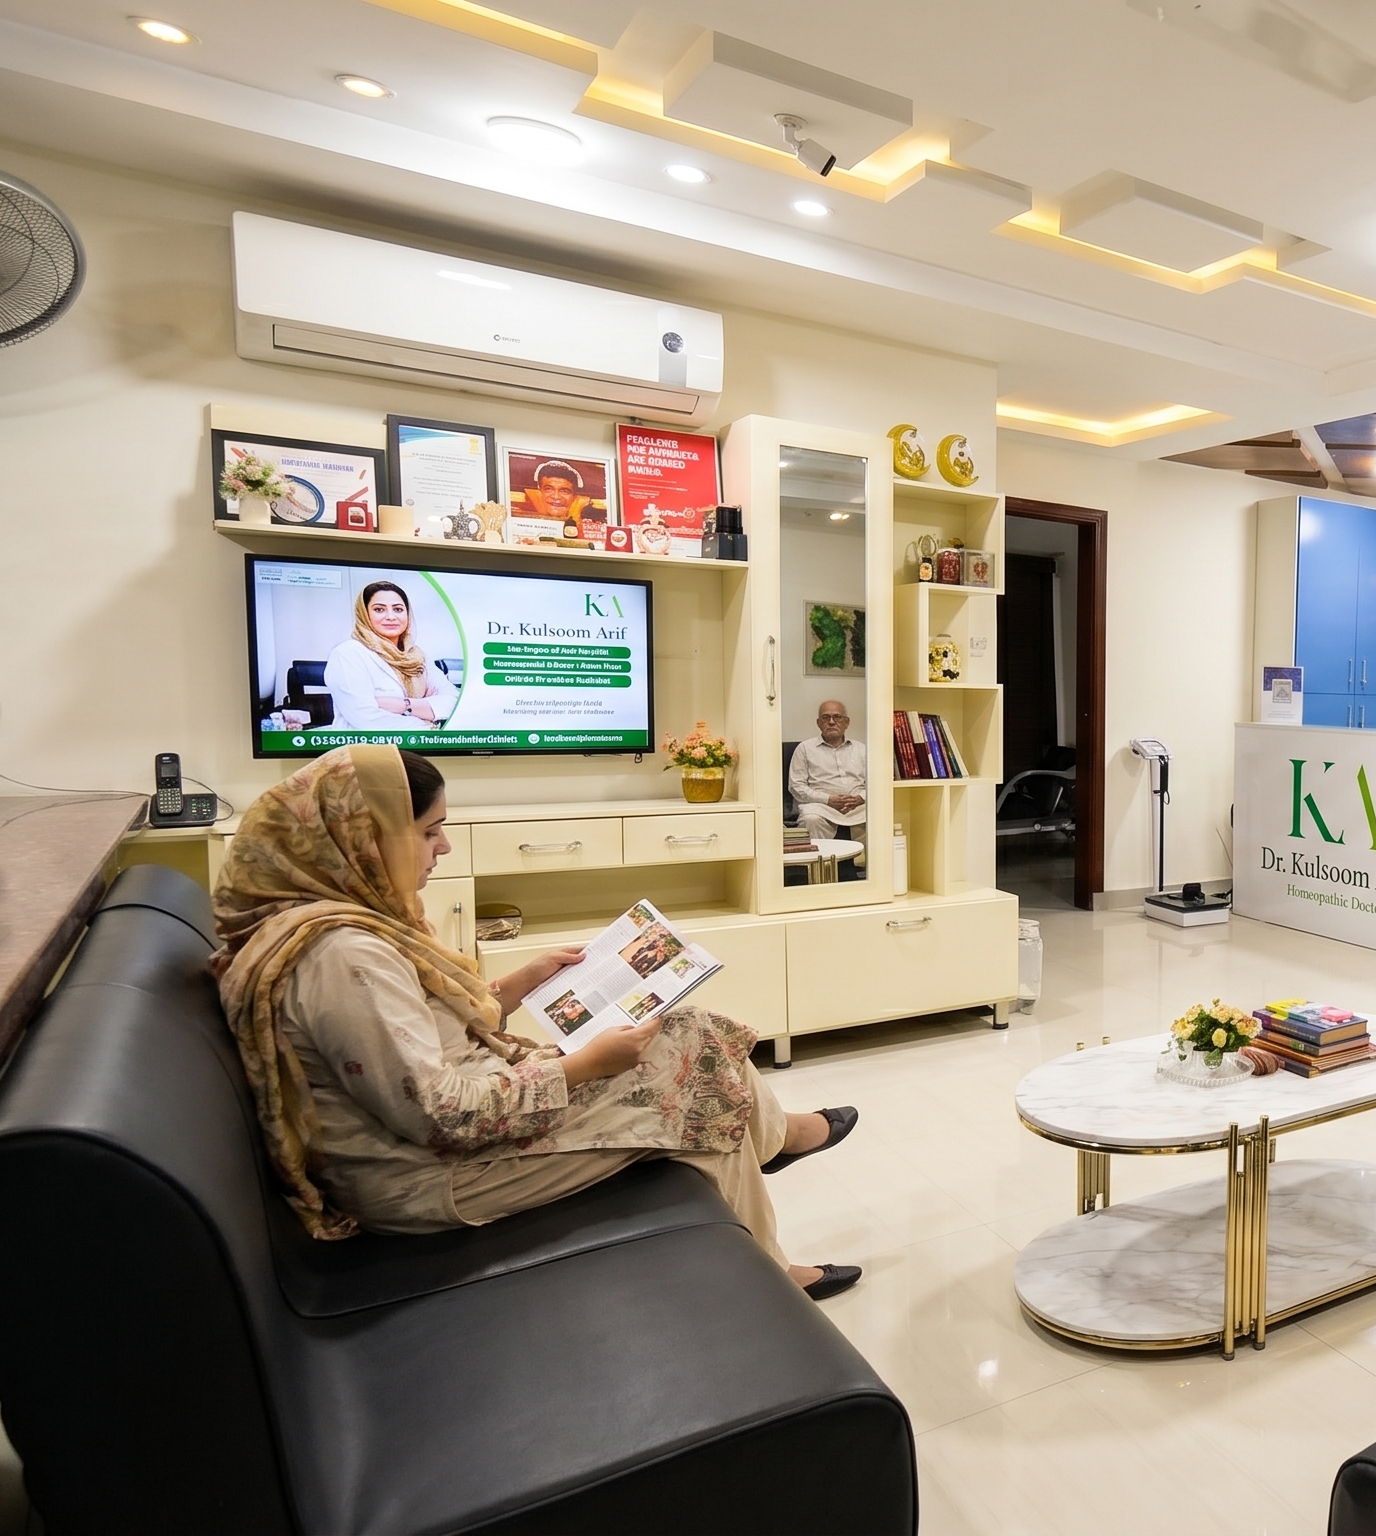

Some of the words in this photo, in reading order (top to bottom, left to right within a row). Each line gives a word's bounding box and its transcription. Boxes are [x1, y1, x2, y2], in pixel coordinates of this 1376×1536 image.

[627, 454, 647, 465] ARE
[487, 620, 514, 635] Dr.
[518, 622, 592, 639] Kulsoom
[596, 626, 629, 640] Arif
[1260, 846, 1287, 873] Dr.
[1291, 852, 1371, 890] Kulsoom
[1286, 883, 1349, 909] Homeopathic
